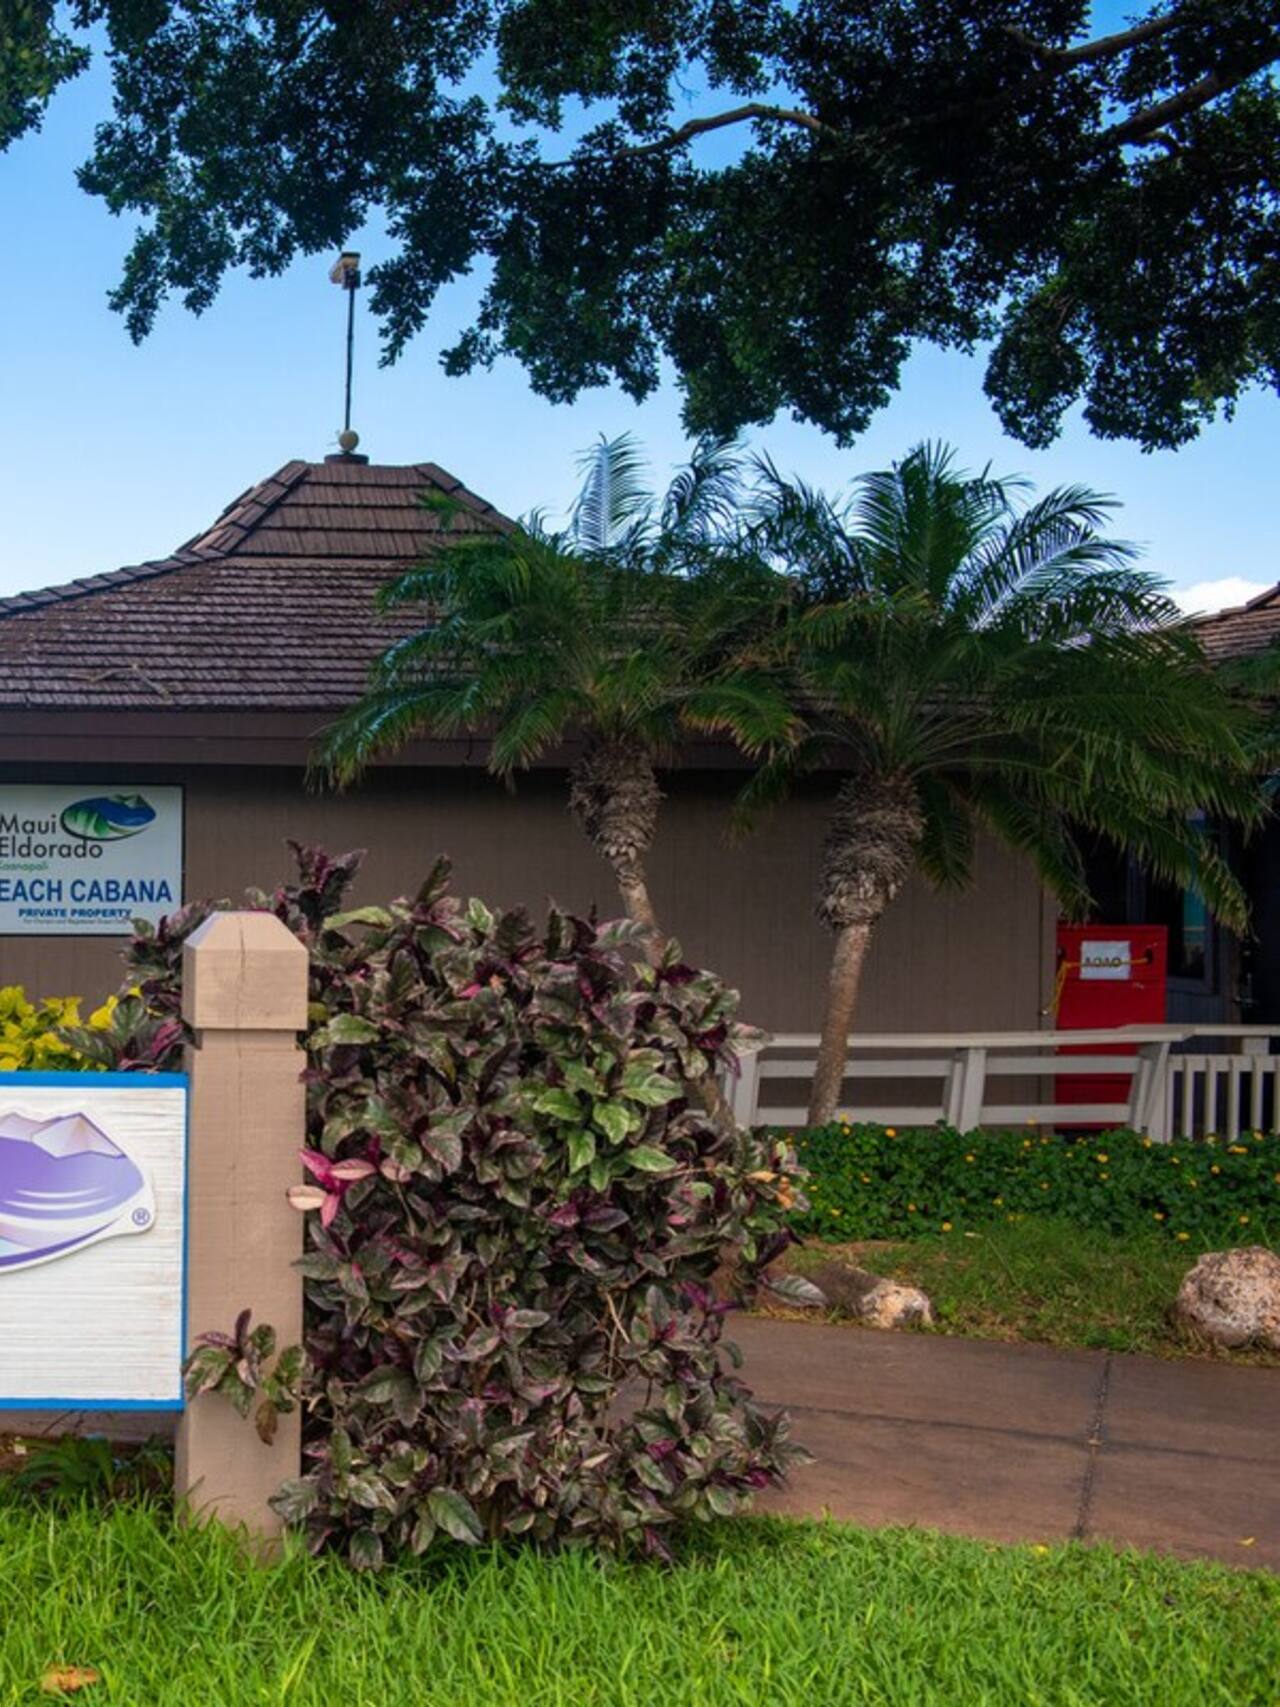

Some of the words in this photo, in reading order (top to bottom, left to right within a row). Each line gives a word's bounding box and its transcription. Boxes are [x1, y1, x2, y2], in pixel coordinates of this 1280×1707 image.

[70, 879, 172, 902] CABANA
[18, 908, 67, 918] PRIVATE
[70, 908, 132, 918] PROPERTY
